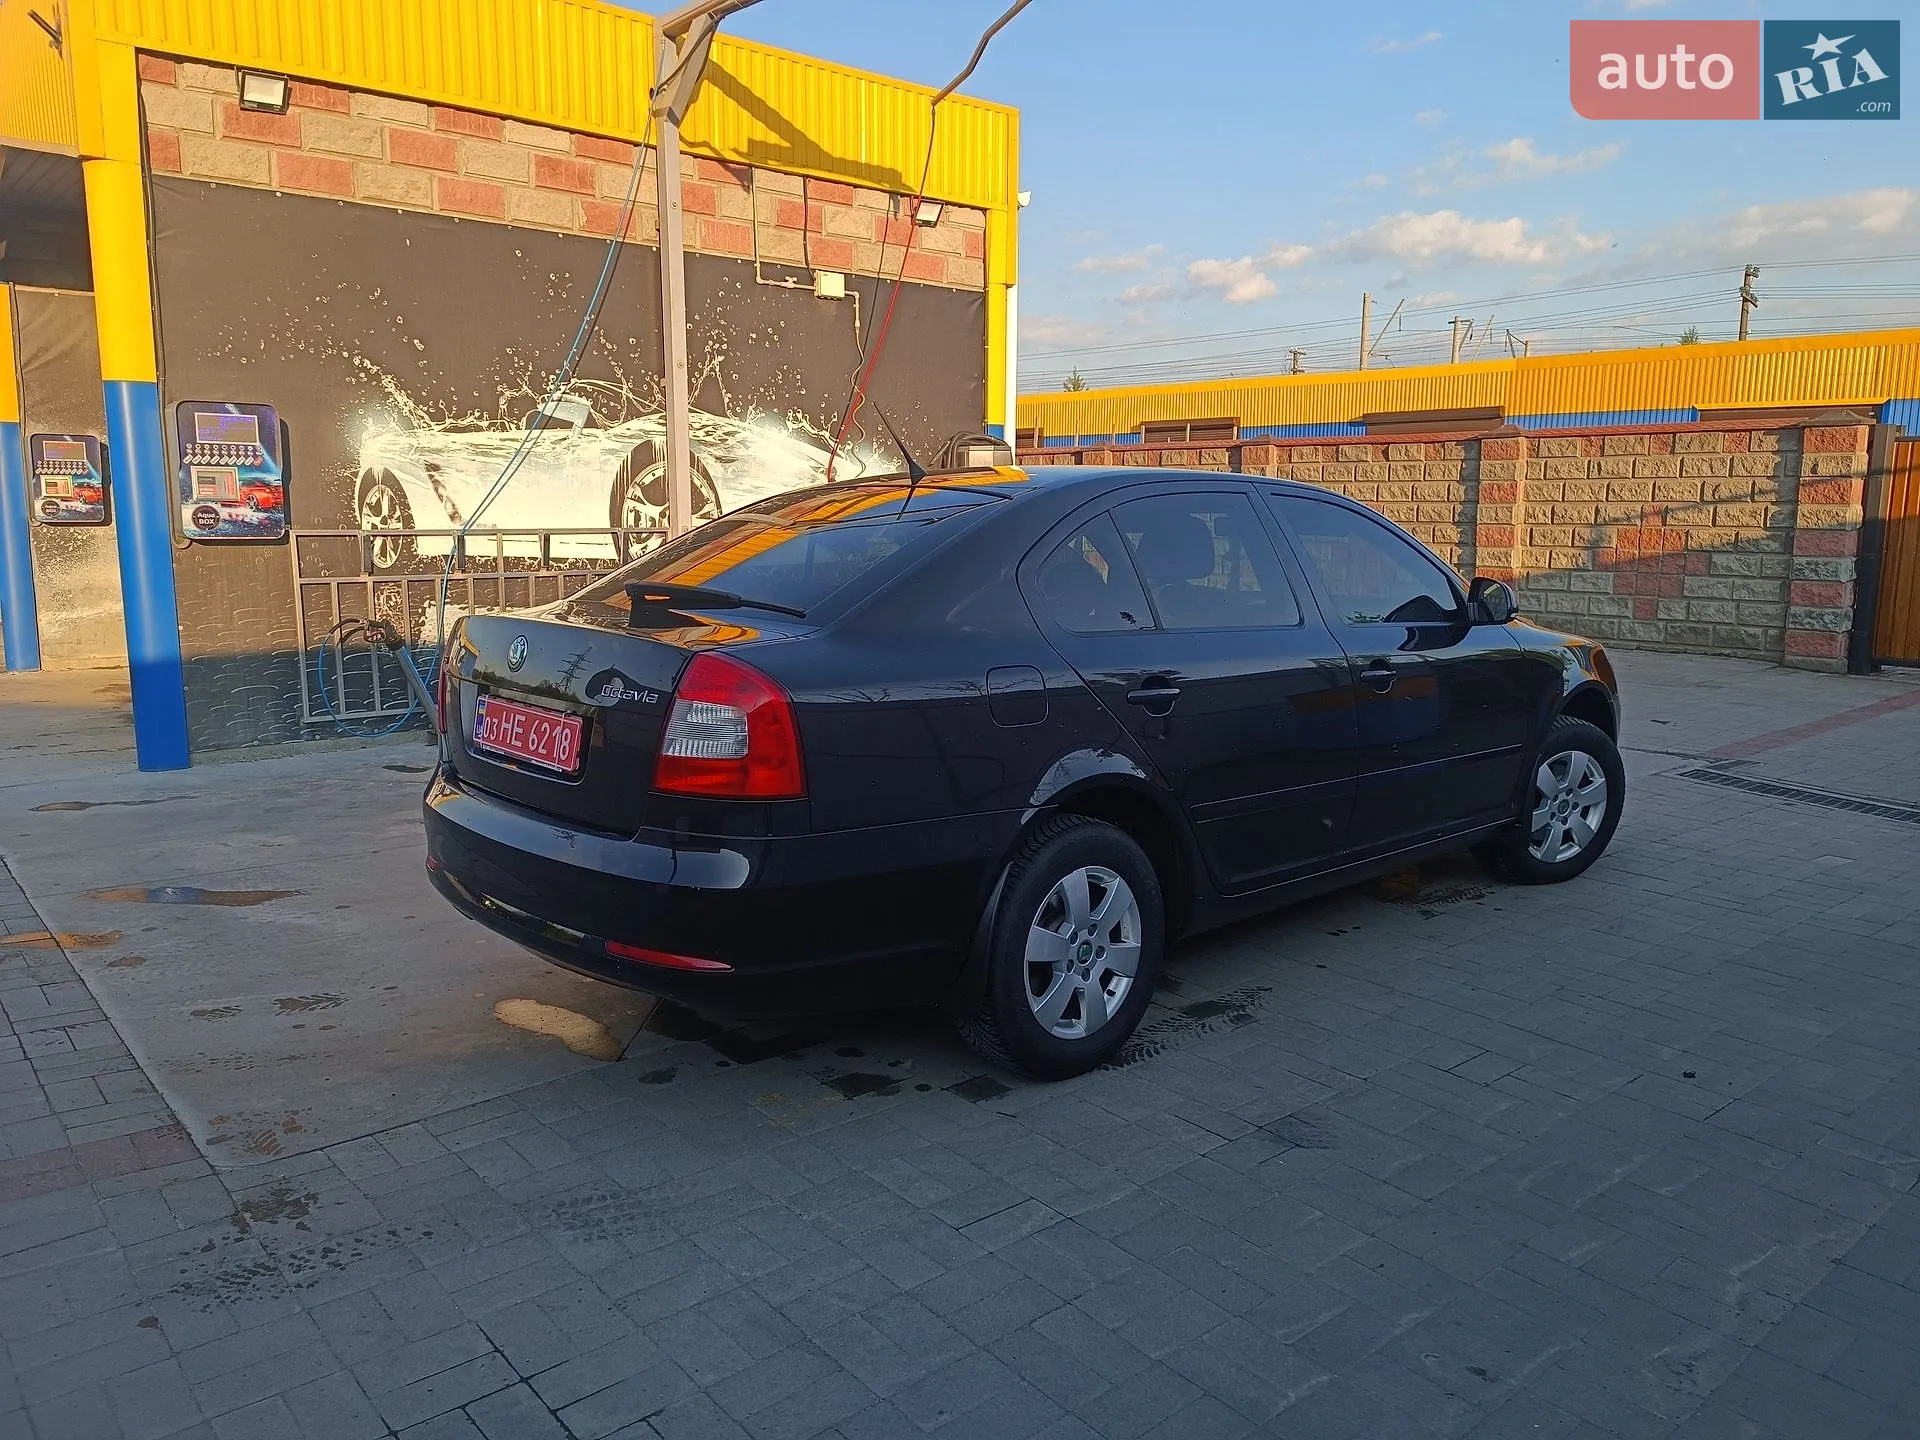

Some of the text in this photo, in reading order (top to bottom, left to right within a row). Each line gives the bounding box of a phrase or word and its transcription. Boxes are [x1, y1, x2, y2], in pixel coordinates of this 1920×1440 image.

[601, 684, 659, 704] Octavia
[483, 716, 498, 741] 03
[500, 711, 526, 748] HE
[528, 720, 571, 761] 6218
